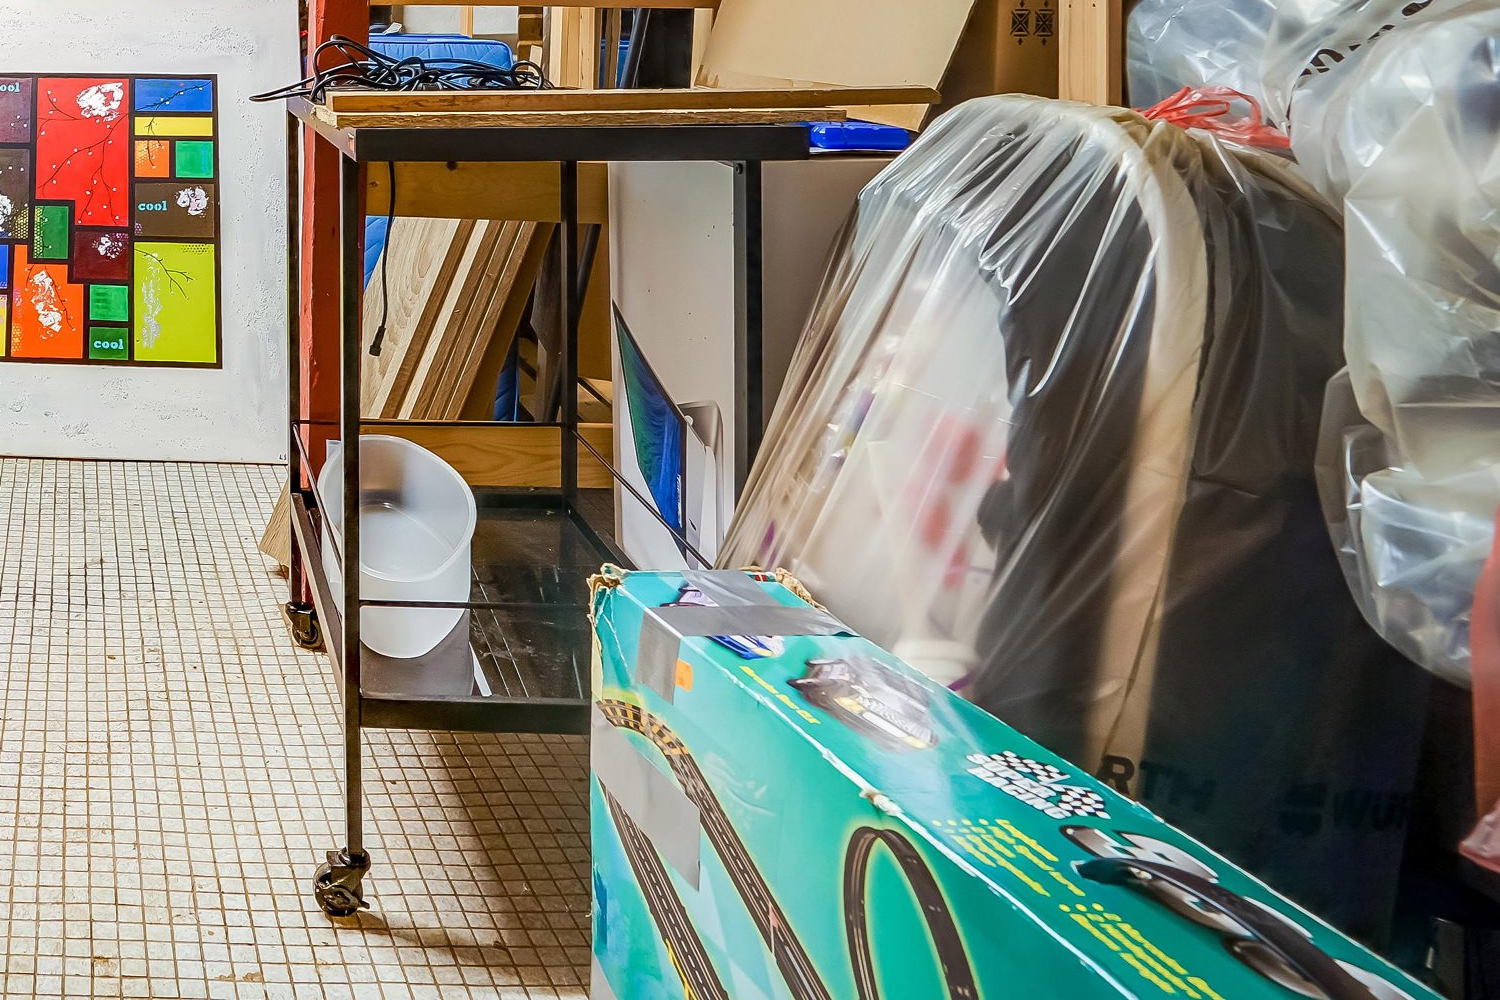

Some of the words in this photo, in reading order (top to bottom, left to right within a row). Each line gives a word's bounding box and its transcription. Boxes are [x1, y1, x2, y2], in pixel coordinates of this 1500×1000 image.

[137, 200, 167, 211] cool
[93, 338, 124, 350] cool
[966, 766, 1072, 820] RACING
